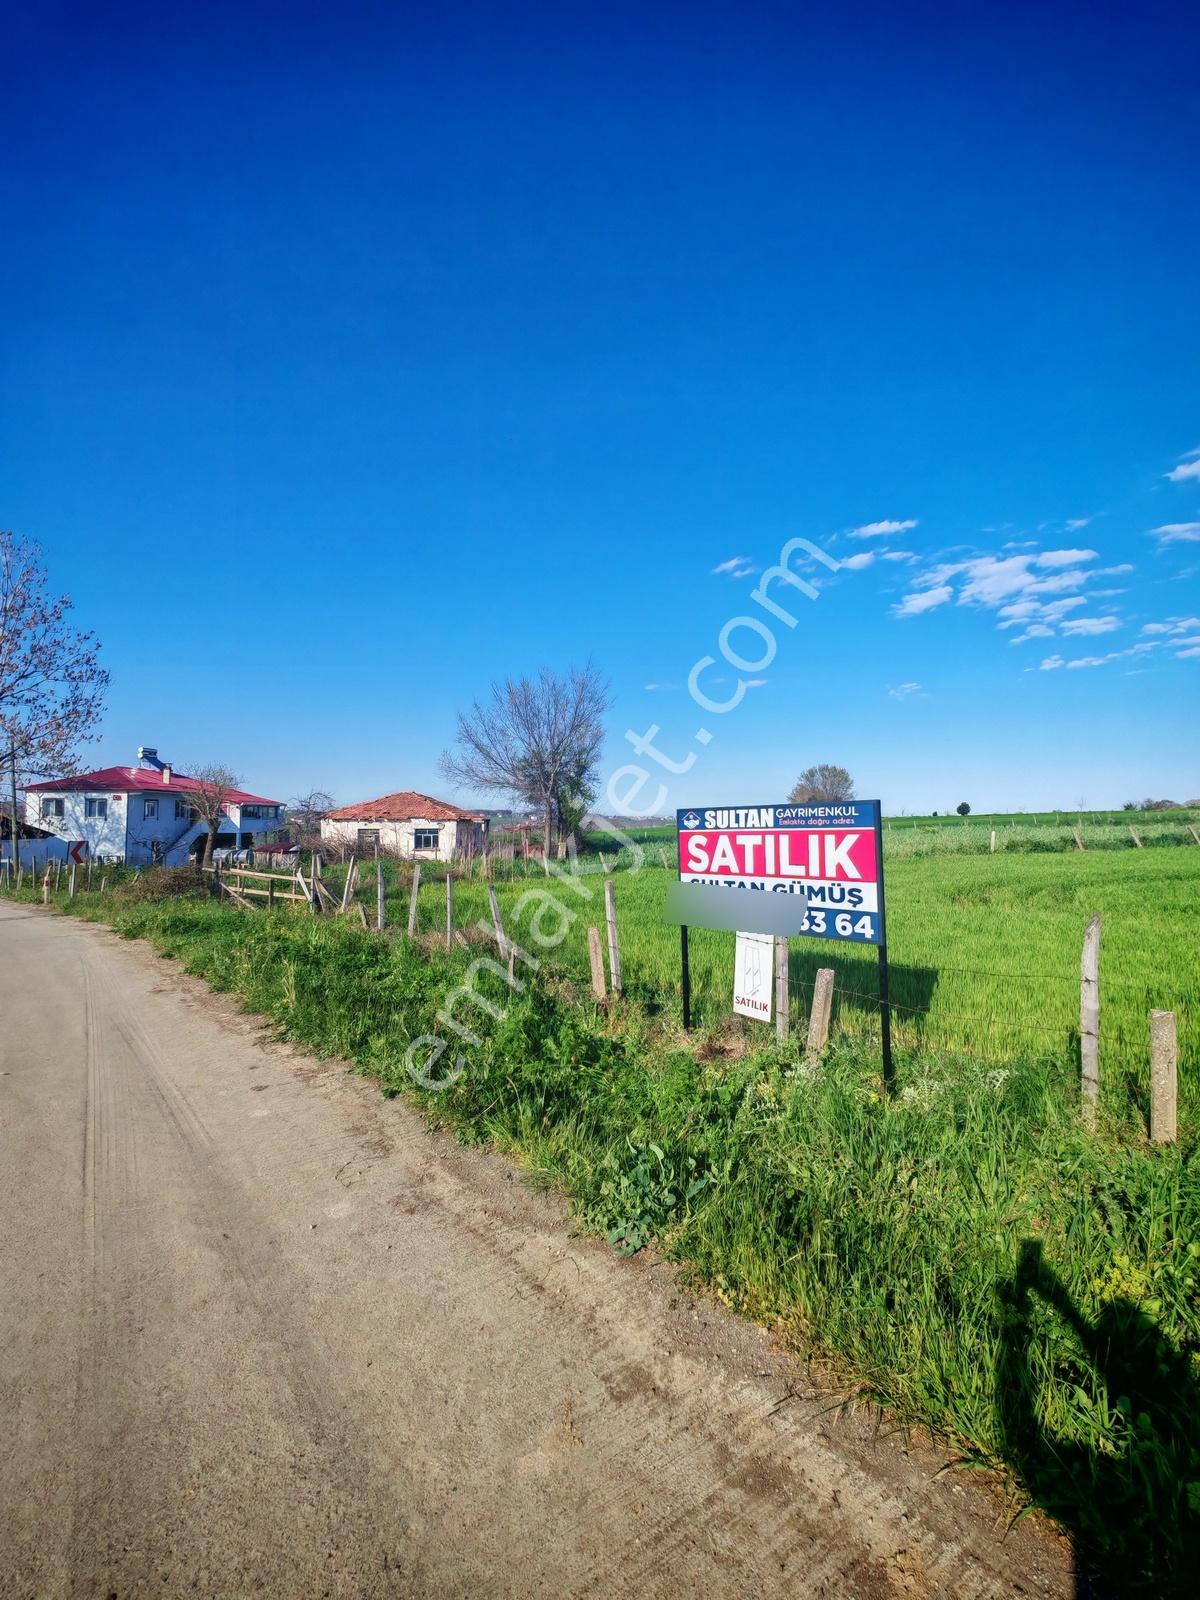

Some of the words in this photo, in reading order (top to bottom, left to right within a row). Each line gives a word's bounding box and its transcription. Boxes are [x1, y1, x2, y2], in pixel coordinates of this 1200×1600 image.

[704, 808, 774, 829] SULTAN
[807, 817, 830, 826] doğru
[832, 817, 855, 825] adres
[687, 834, 862, 879] SATILIK
[834, 913, 875, 939] 64
[735, 995, 769, 1012] SATILIK
